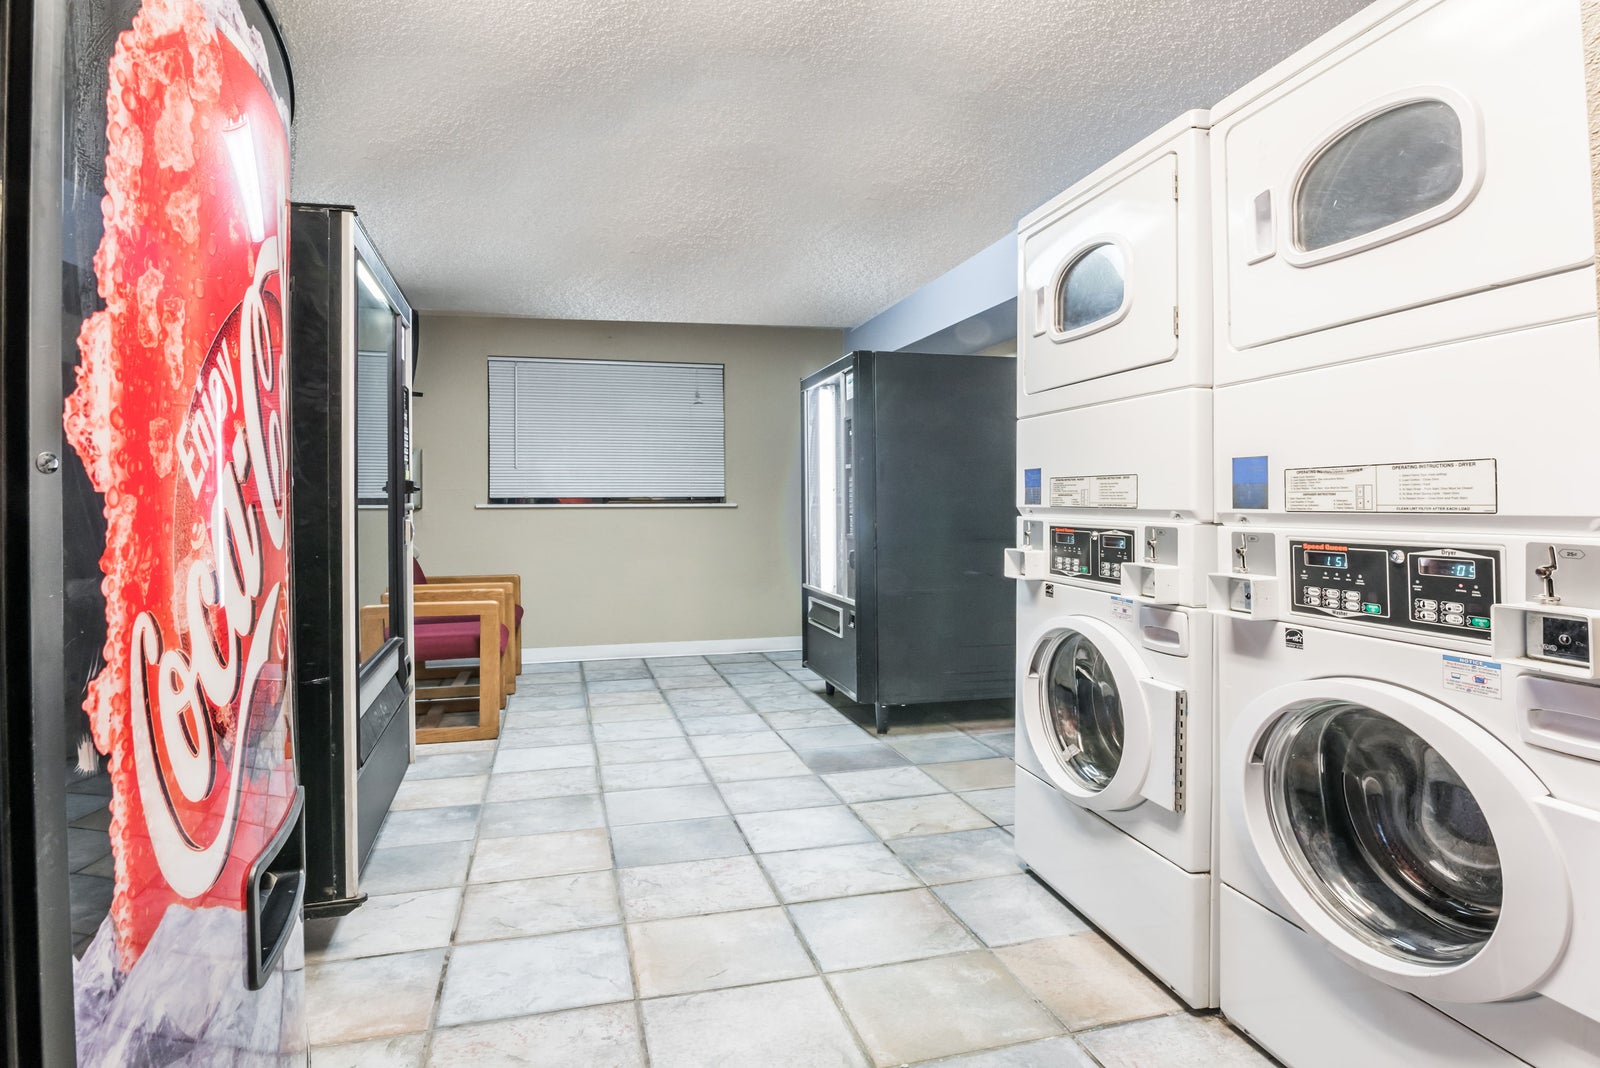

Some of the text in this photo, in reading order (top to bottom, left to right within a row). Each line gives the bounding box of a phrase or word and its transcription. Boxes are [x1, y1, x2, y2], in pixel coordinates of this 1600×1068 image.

[176, 336, 238, 501] Enjoy
[1302, 543, 1348, 552] Speed Queen
[1459, 658, 1483, 666] NOTICE
